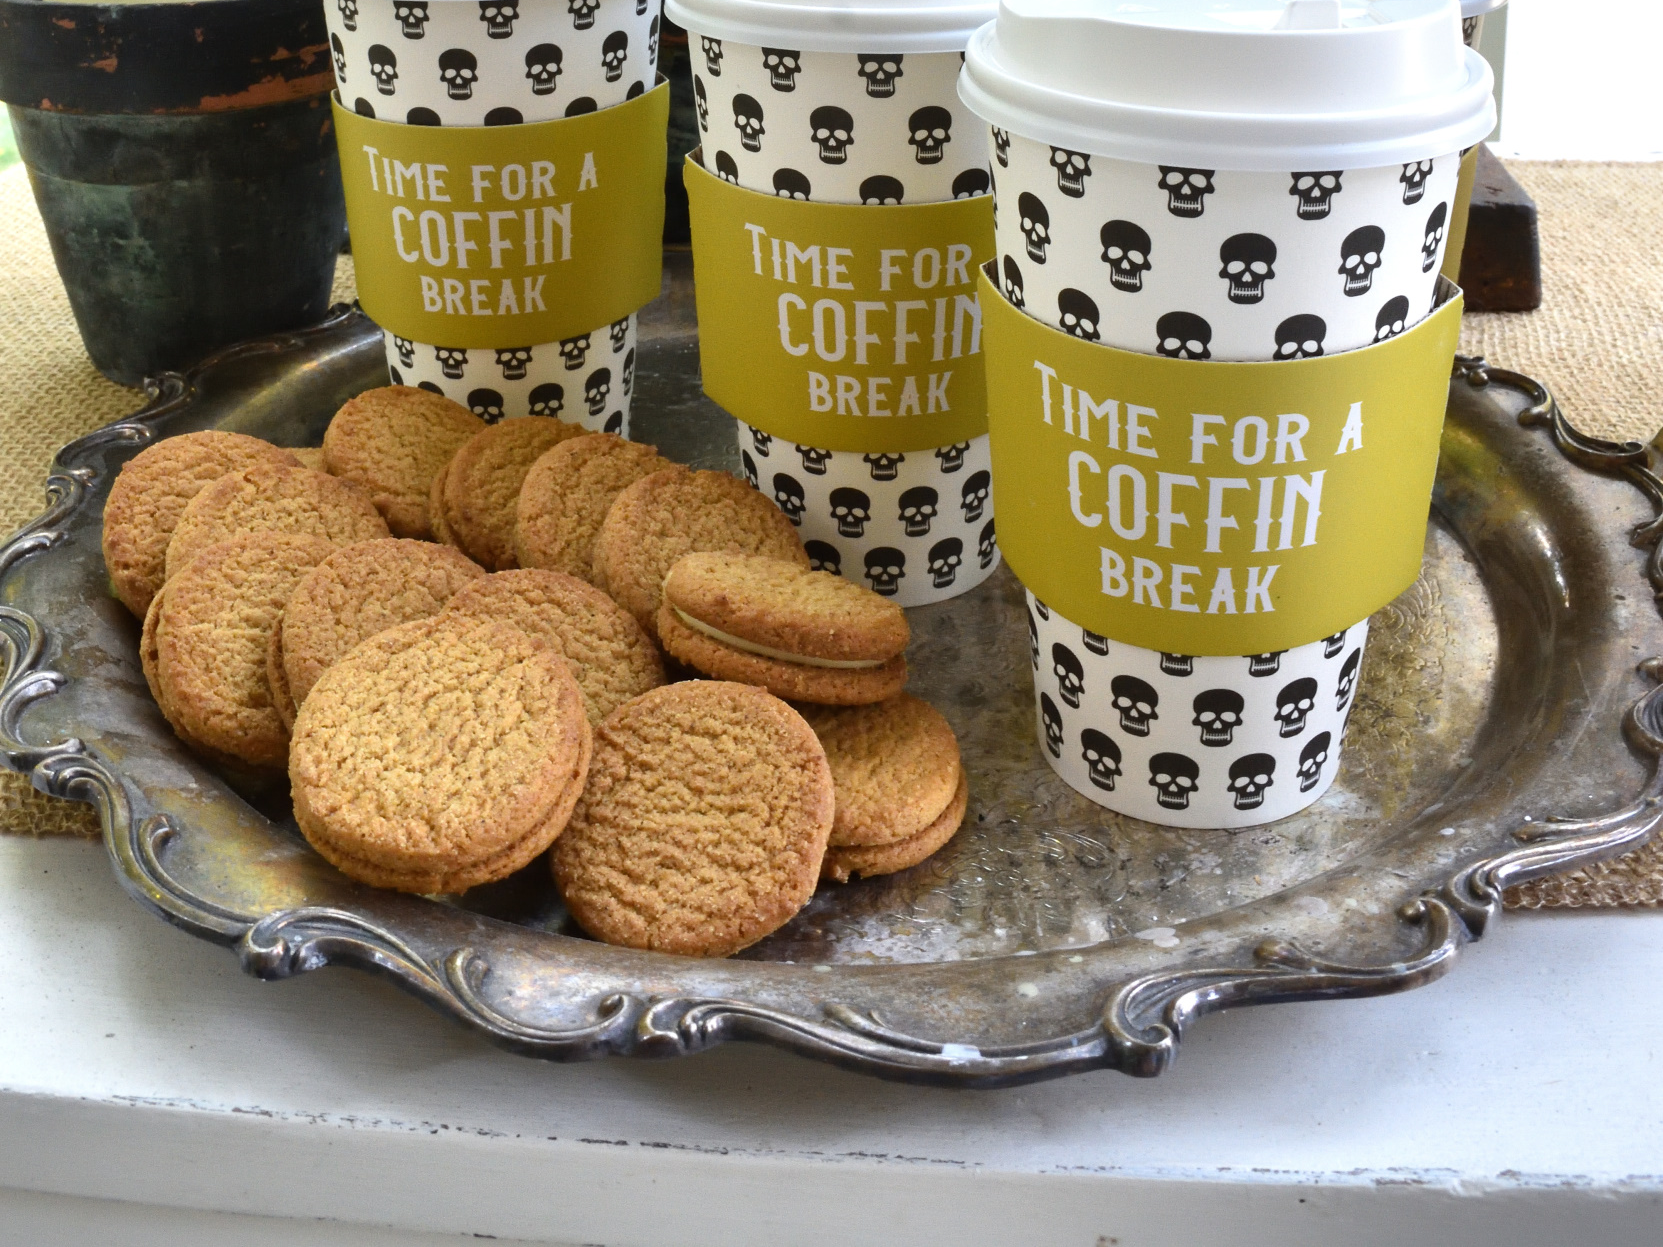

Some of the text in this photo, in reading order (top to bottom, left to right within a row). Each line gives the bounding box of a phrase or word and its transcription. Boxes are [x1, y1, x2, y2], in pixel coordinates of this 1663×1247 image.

[362, 144, 599, 203] TIME FOR A
[391, 202, 573, 268] COFFIN
[744, 222, 973, 292] TIME FOR
[420, 274, 548, 316] BREAK
[777, 291, 984, 365] COFFIN
[806, 370, 953, 417] BREAK
[1033, 360, 1365, 466] TIME FOR A
[1066, 450, 1329, 554] COFFIN
[1098, 546, 1282, 615] BREAK
